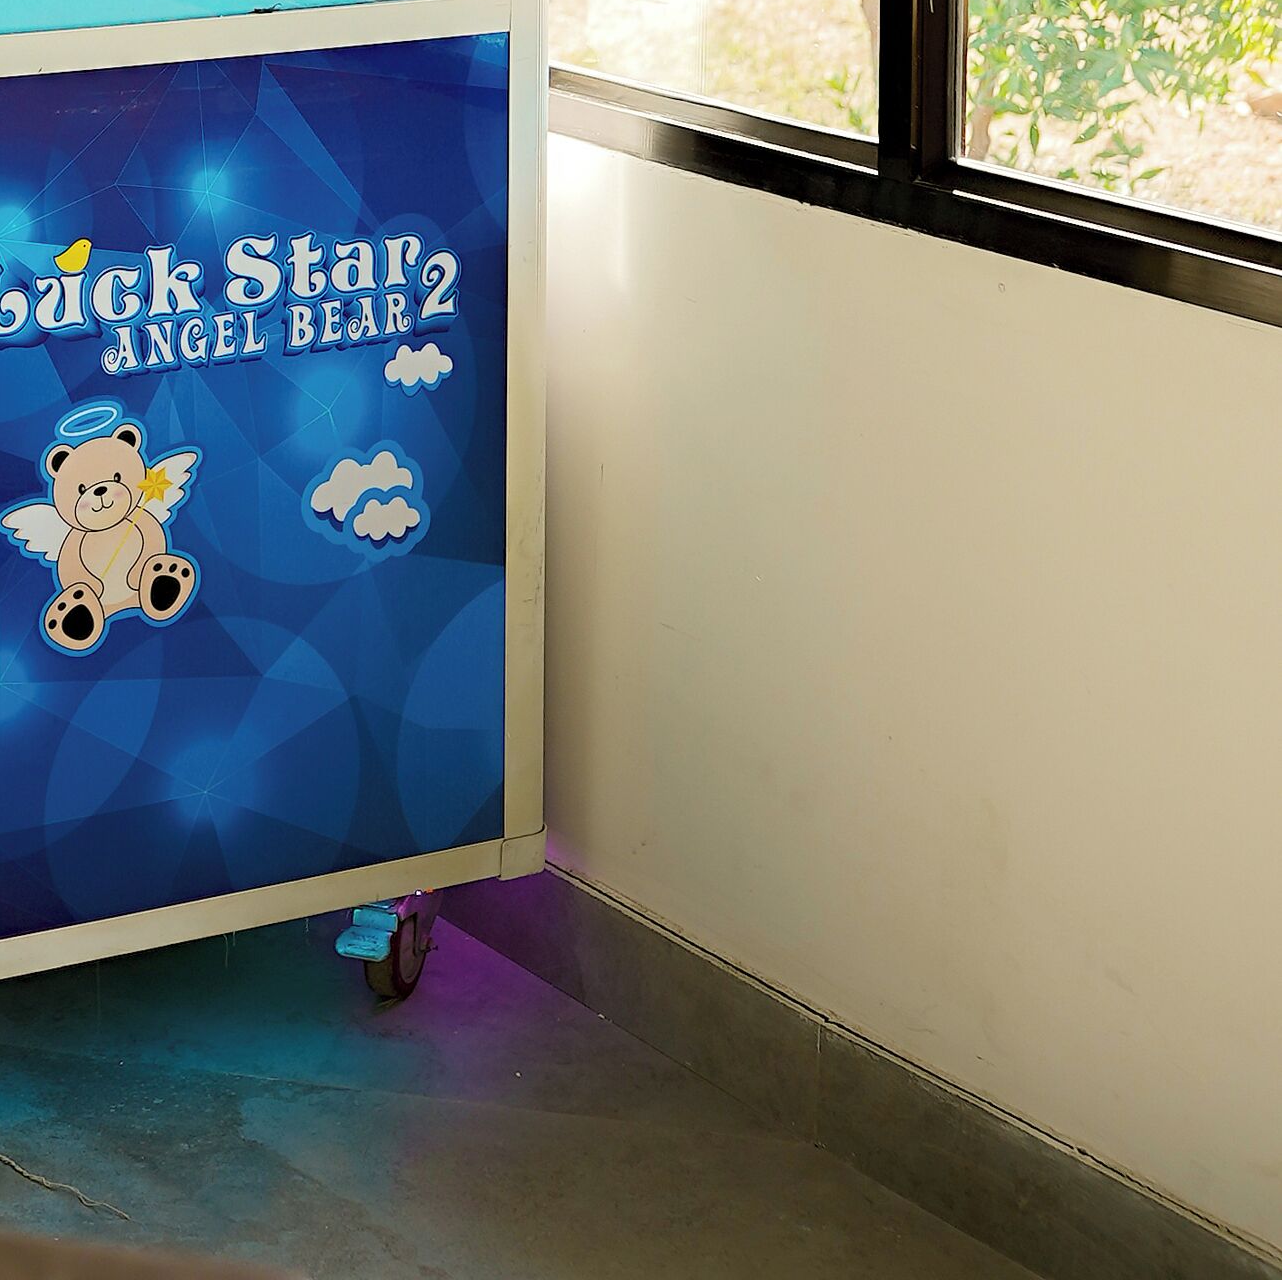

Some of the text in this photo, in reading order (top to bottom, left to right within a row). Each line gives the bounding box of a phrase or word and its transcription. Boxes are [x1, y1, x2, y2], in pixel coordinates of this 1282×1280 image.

[224, 232, 425, 307] Star
[100, 292, 416, 376] ANGEL BEAR
